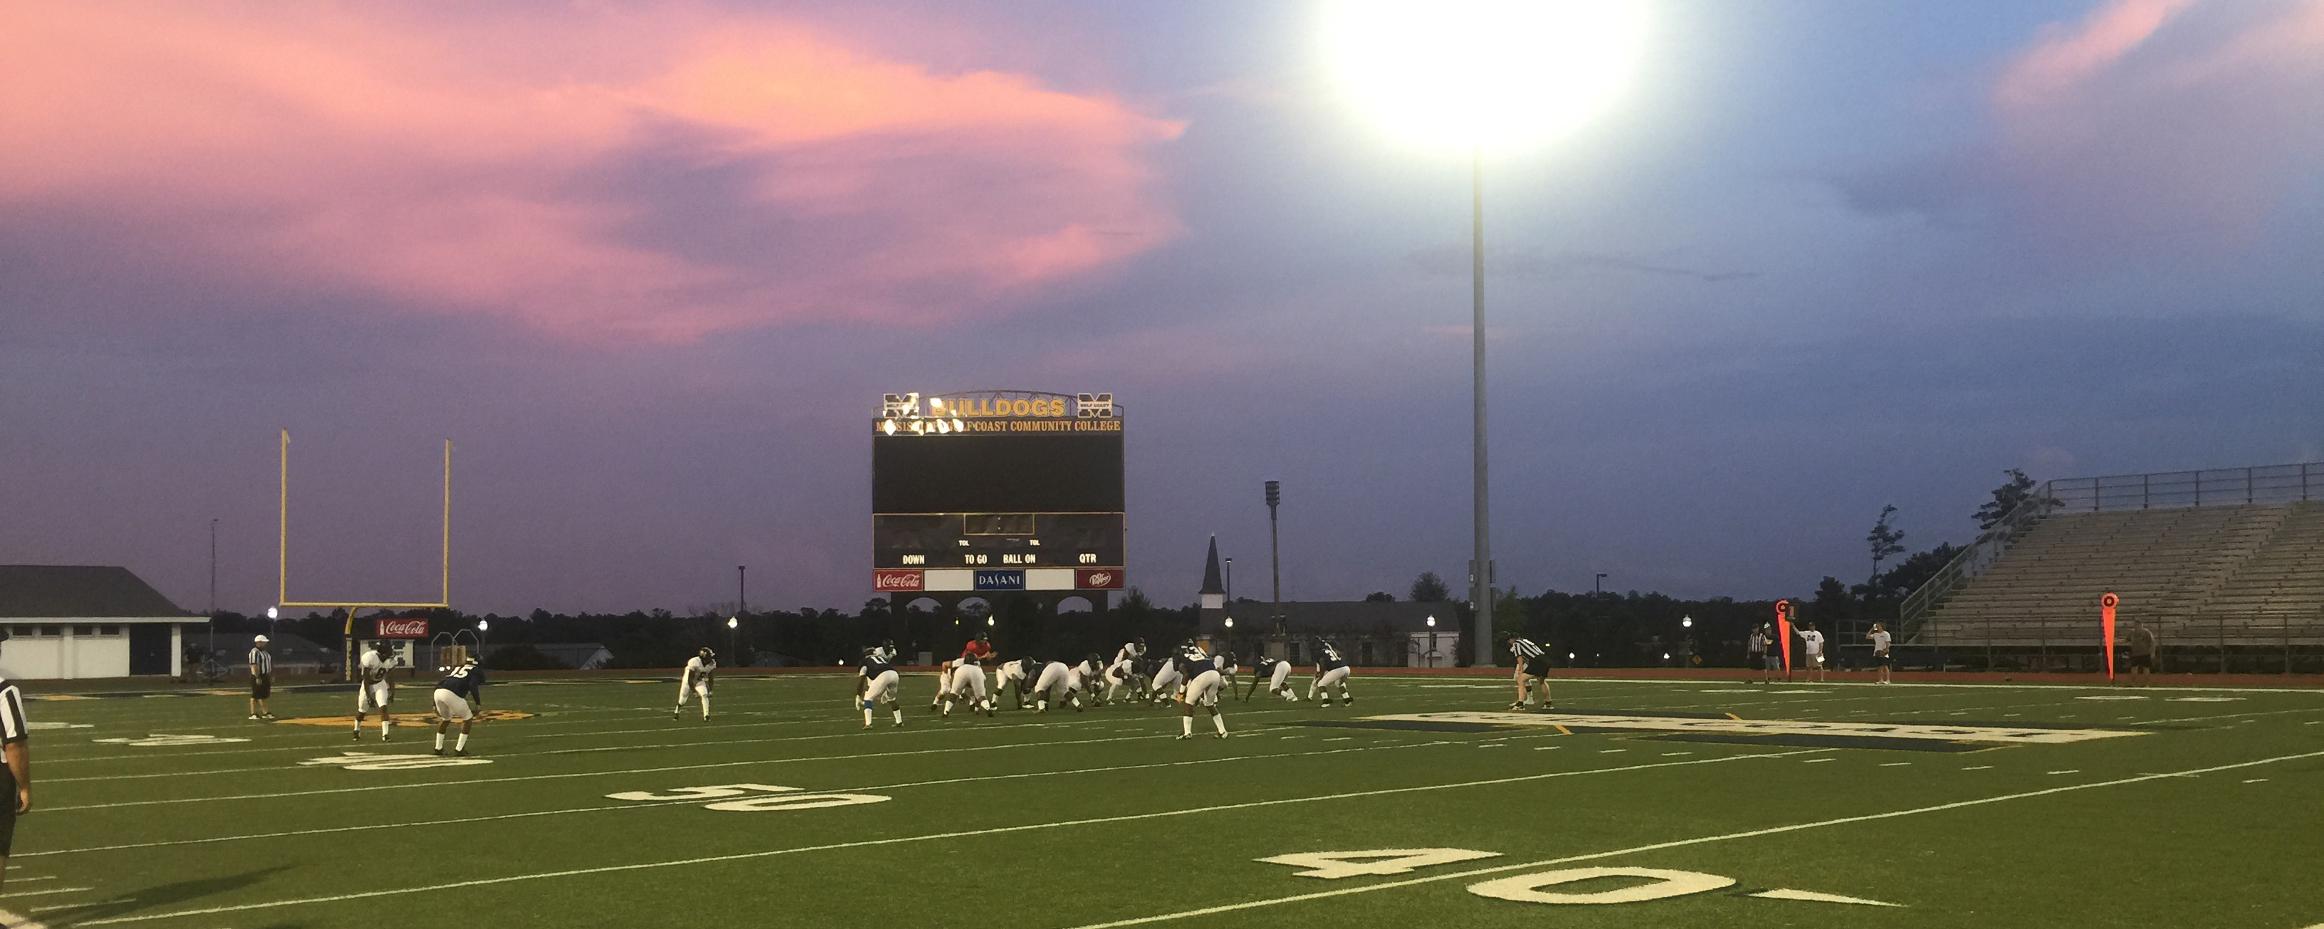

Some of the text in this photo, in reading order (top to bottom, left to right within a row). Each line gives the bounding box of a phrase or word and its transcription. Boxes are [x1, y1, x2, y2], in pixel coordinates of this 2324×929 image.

[931, 399, 1065, 417] BULLDOGS
[975, 421, 1008, 431] COAST
[1010, 421, 1072, 431] COMMUNITY
[1074, 420, 1121, 431] COLLEGE
[902, 554, 925, 565] DOWN
[964, 554, 988, 564] TO GO
[1003, 554, 1036, 564] BALL ON
[1079, 553, 1097, 564] QTR
[979, 575, 1020, 587] DASANI
[604, 783, 893, 811] 50
[1251, 847, 1738, 904] 40
